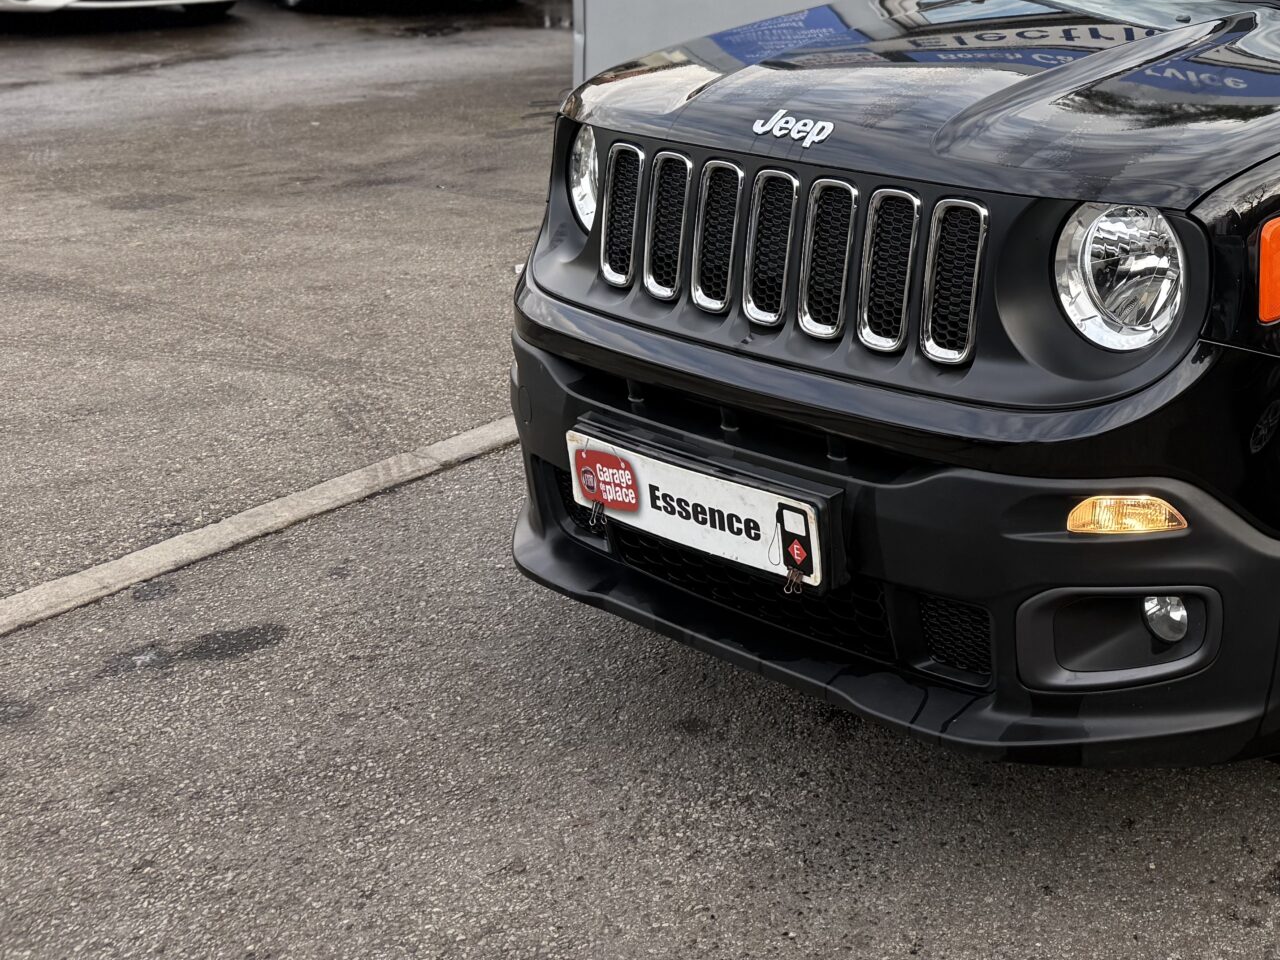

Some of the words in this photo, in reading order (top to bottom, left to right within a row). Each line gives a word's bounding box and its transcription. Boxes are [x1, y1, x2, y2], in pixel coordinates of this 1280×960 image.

[752, 108, 835, 149] Jeep
[596, 463, 633, 488] Garage
[606, 482, 636, 504] place
[648, 483, 762, 541] Essence
[794, 544, 801, 560] E
